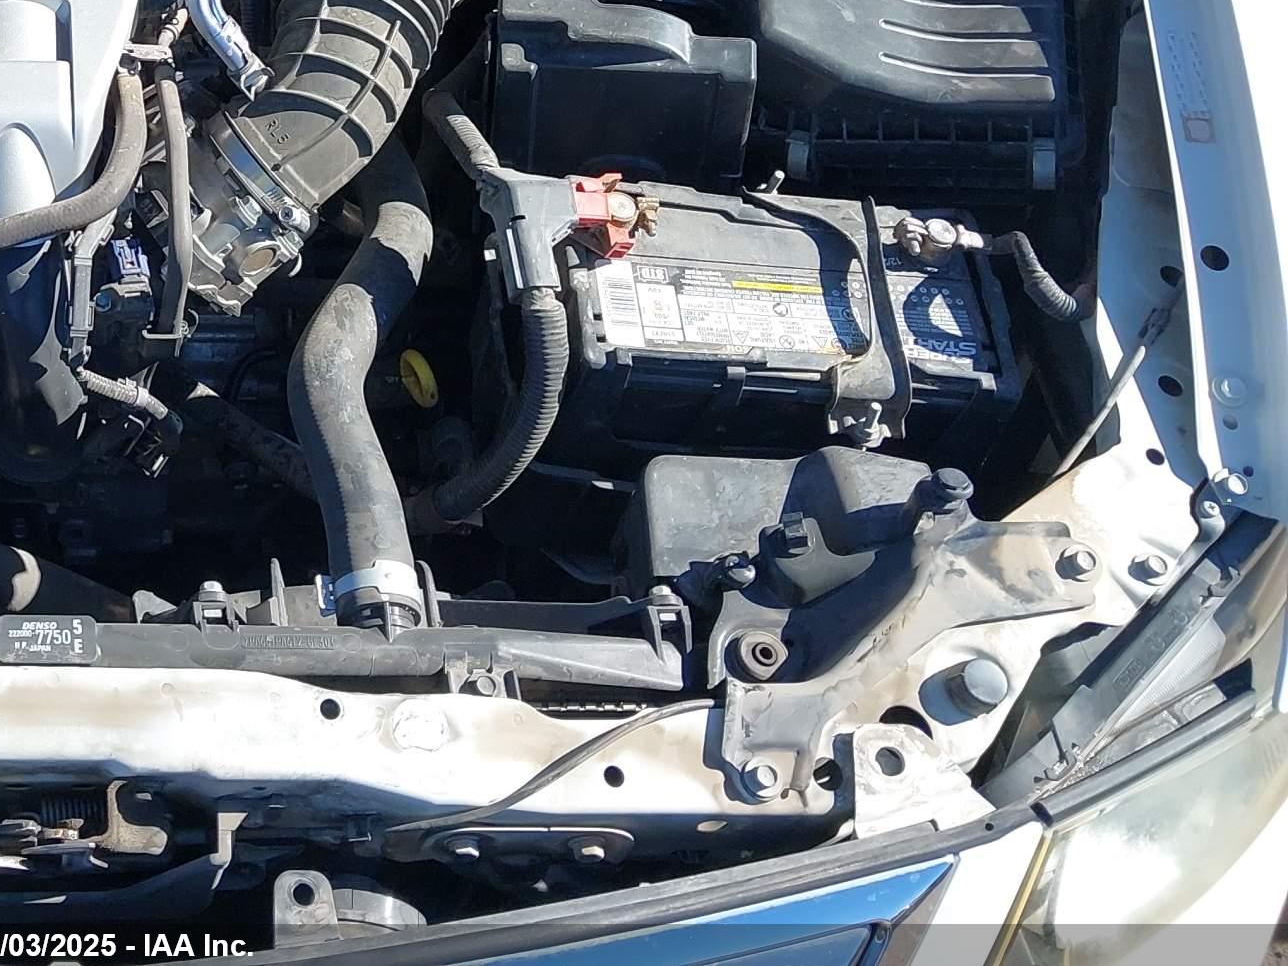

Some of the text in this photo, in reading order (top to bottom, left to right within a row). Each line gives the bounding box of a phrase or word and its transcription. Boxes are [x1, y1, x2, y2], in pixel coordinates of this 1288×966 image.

[904, 337, 976, 354] START
[904, 346, 972, 364] SUPER
[21, 621, 58, 630] DENSO
[72, 618, 83, 634] 5
[74, 638, 84, 654] E
